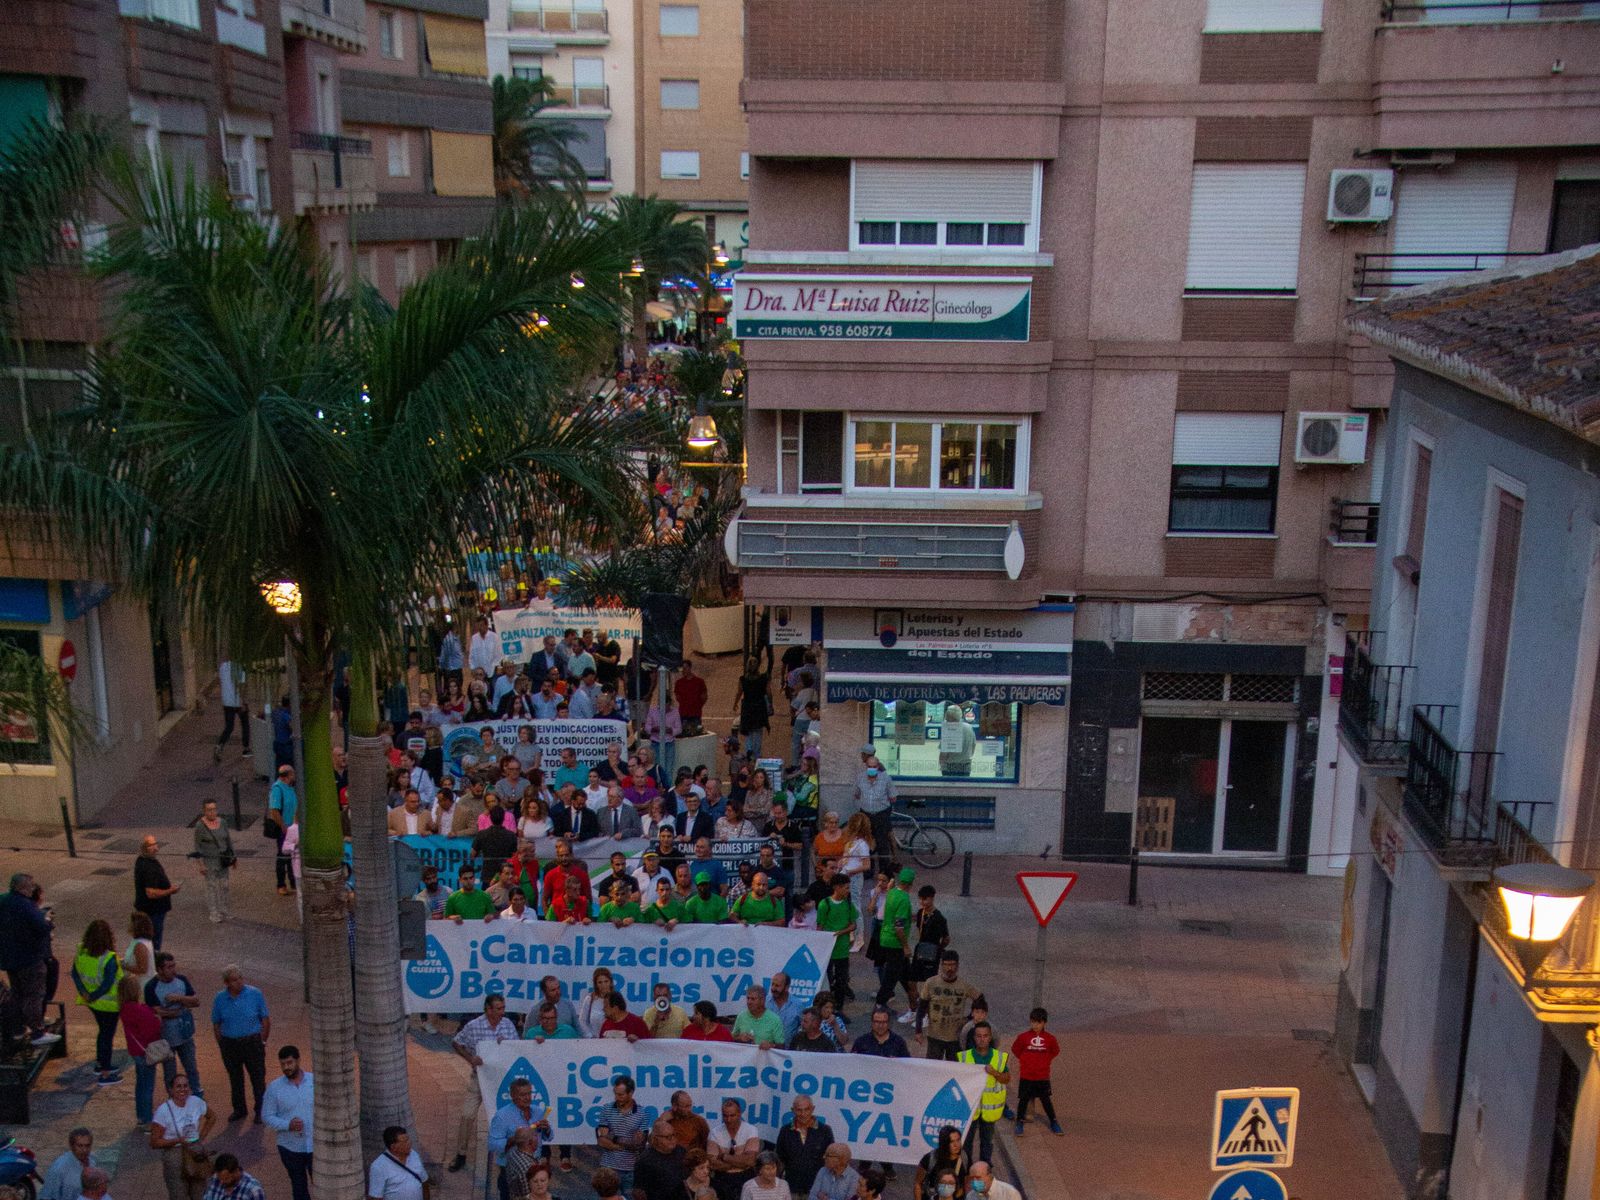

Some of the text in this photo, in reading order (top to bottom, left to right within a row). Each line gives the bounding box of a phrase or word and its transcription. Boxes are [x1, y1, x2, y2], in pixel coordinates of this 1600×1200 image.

[744, 287, 787, 311] Dra.
[828, 289, 880, 312] Luisa
[884, 289, 930, 313] Ruiz
[934, 300, 993, 318] Ginecóloga
[758, 325, 893, 338] CITA PREVIA: 958 608774
[907, 613, 964, 626] Loterías y
[907, 627, 1023, 639] Apuestas del Estado
[937, 651, 993, 659] Estado
[874, 687, 890, 699] DE
[469, 935, 755, 969] ¡Canalizaciones
[566, 1055, 895, 1105] ¡Canalizaciones
[840, 1108, 914, 1148] YA!
